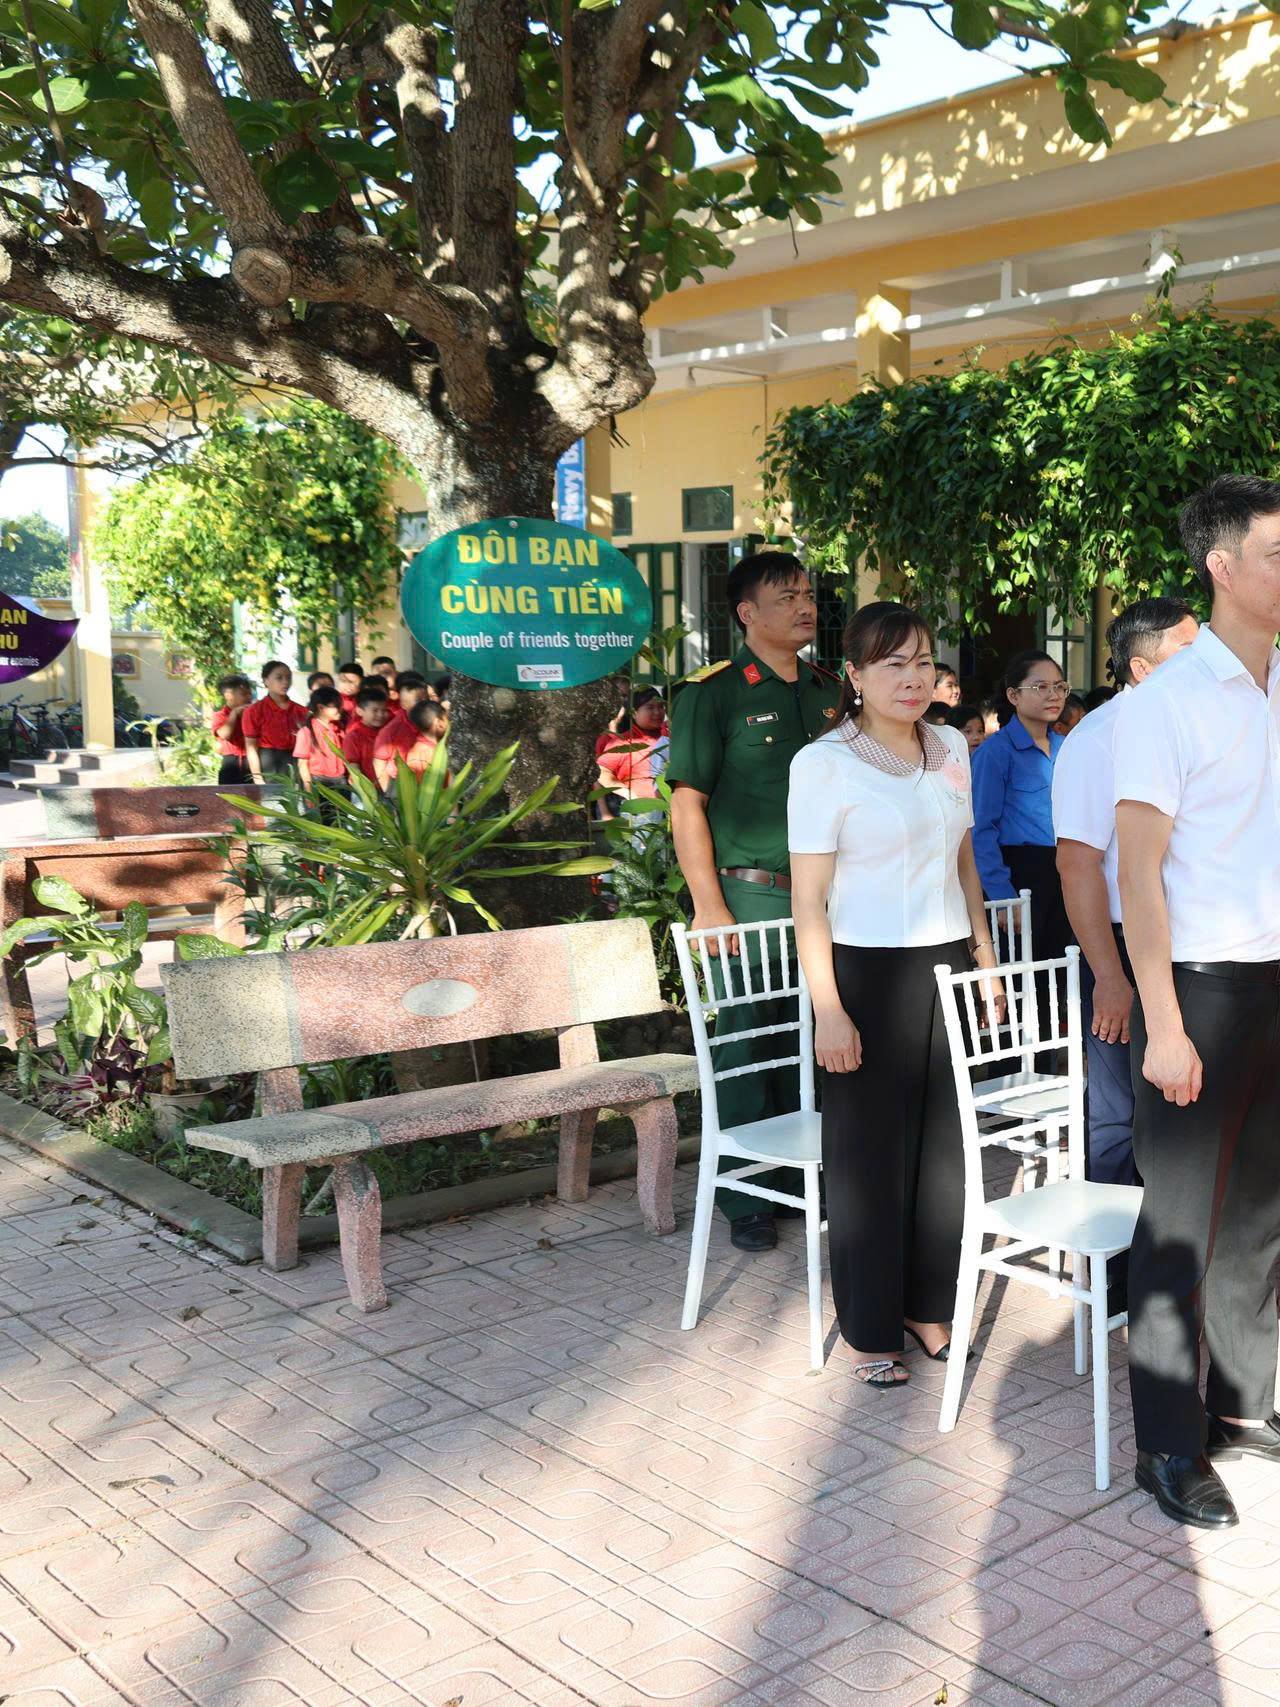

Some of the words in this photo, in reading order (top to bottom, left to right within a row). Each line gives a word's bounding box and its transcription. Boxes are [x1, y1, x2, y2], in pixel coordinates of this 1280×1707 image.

[560, 467, 584, 521] Navy
[457, 529, 518, 564] ĐÔI
[529, 537, 599, 572] BẠN
[440, 579, 541, 615] CÙNG
[548, 578, 624, 615] TIẾN
[0, 608, 27, 627] ẠN
[0, 631, 18, 650] HÙ
[441, 631, 494, 652] Couple
[500, 631, 514, 648] of
[520, 631, 570, 648] friends
[575, 631, 634, 651] together
